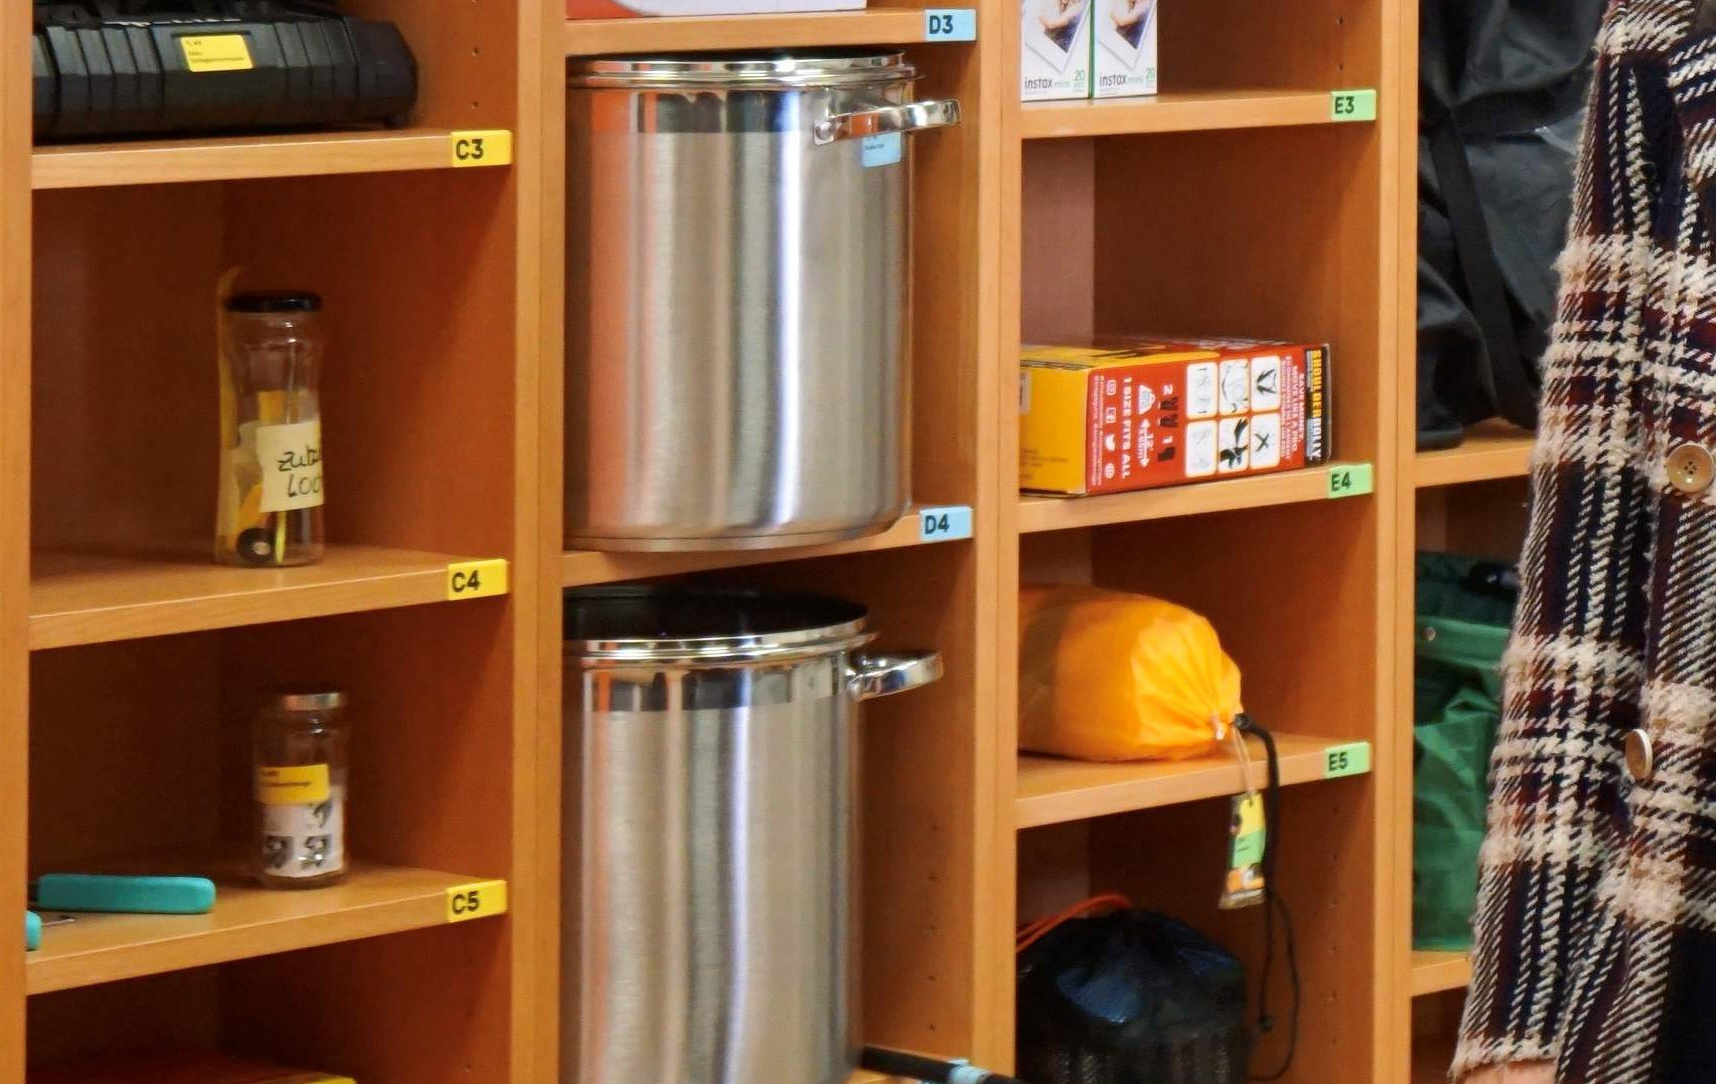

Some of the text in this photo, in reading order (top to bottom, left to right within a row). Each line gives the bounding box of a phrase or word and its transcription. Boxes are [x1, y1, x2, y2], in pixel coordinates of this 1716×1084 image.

[930, 14, 954, 35] D3
[1024, 76, 1053, 90] instax
[1099, 74, 1126, 87] instax
[1334, 95, 1355, 115] E3
[456, 138, 483, 161] C3
[1163, 384, 1174, 396] 2
[1122, 386, 1132, 416] SIZE
[1122, 419, 1132, 451] FITS
[1121, 453, 1131, 479] ALL
[1331, 471, 1352, 492] E4
[924, 513, 950, 535] D4
[452, 569, 481, 593] C4
[1328, 751, 1348, 772] E5
[452, 890, 480, 915] C5
